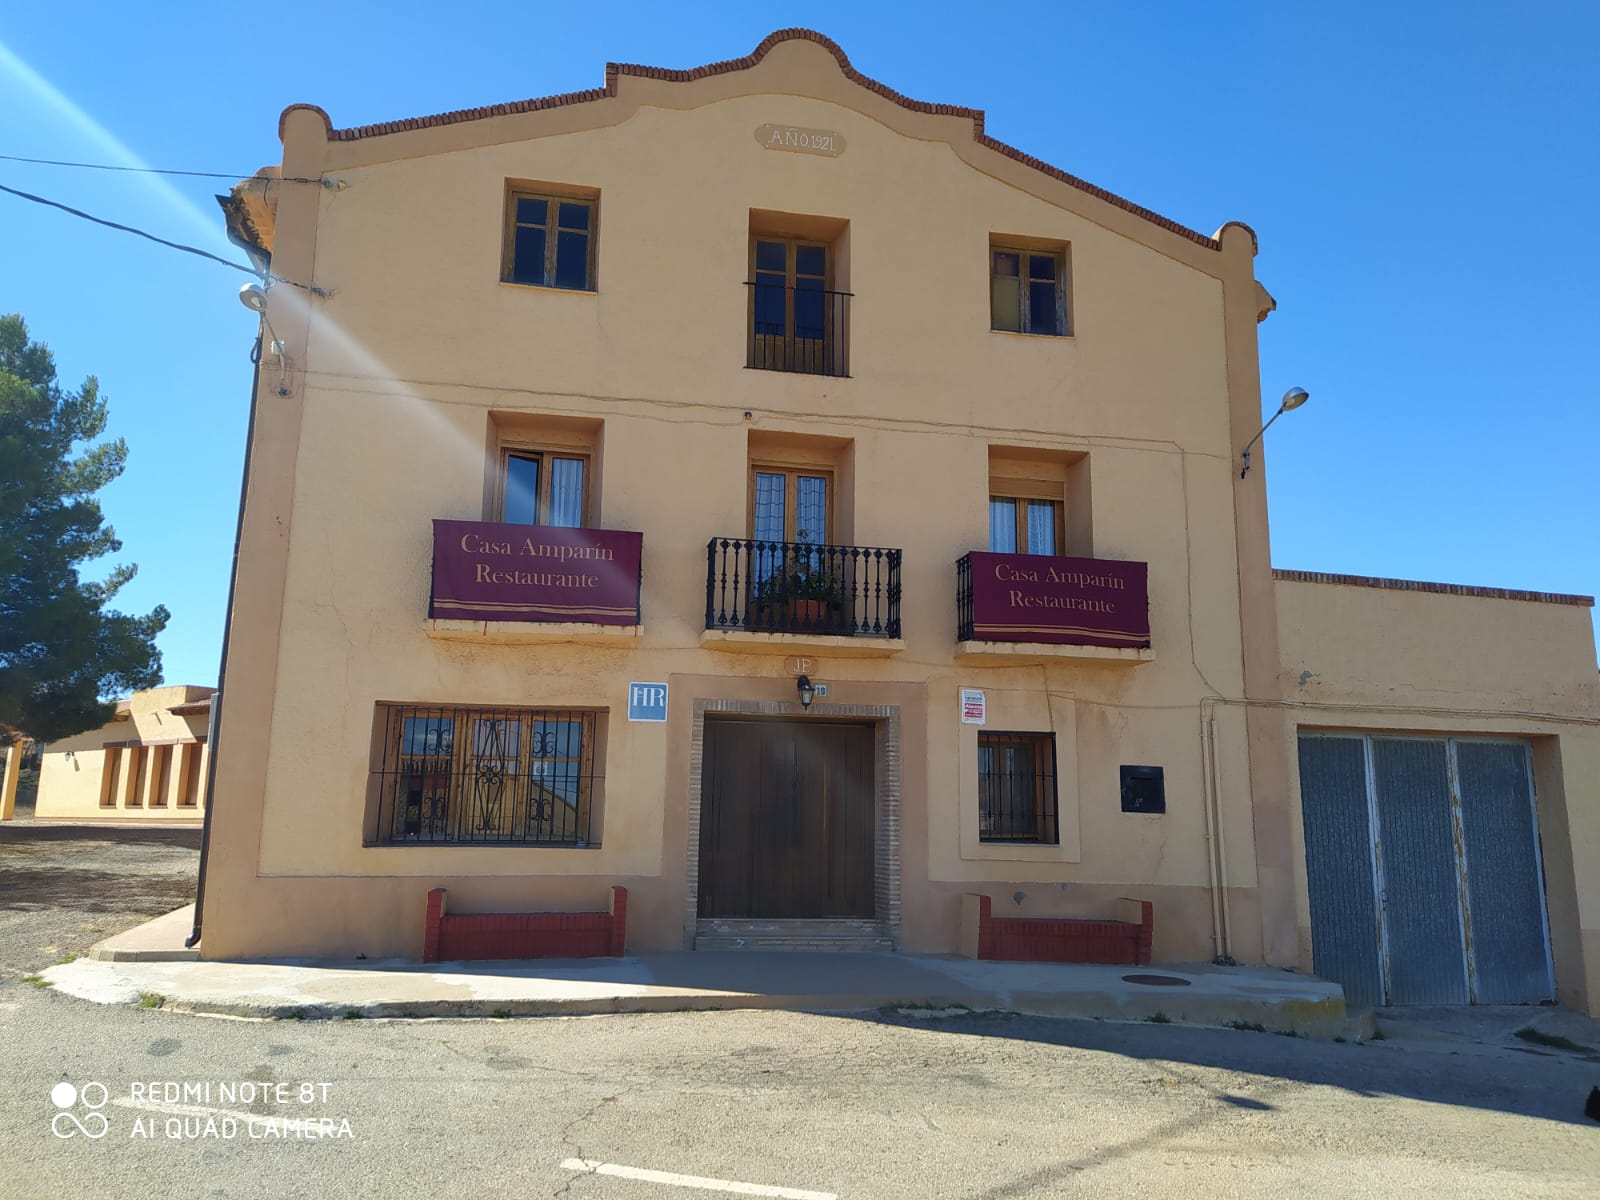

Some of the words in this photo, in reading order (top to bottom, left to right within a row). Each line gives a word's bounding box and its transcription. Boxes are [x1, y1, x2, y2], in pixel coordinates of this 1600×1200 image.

[461, 534, 511, 555] Casa
[520, 538, 614, 562] Amparín
[475, 564, 600, 588] Restaurante
[995, 564, 1039, 582] Casa
[1009, 590, 1115, 614] Restaurante
